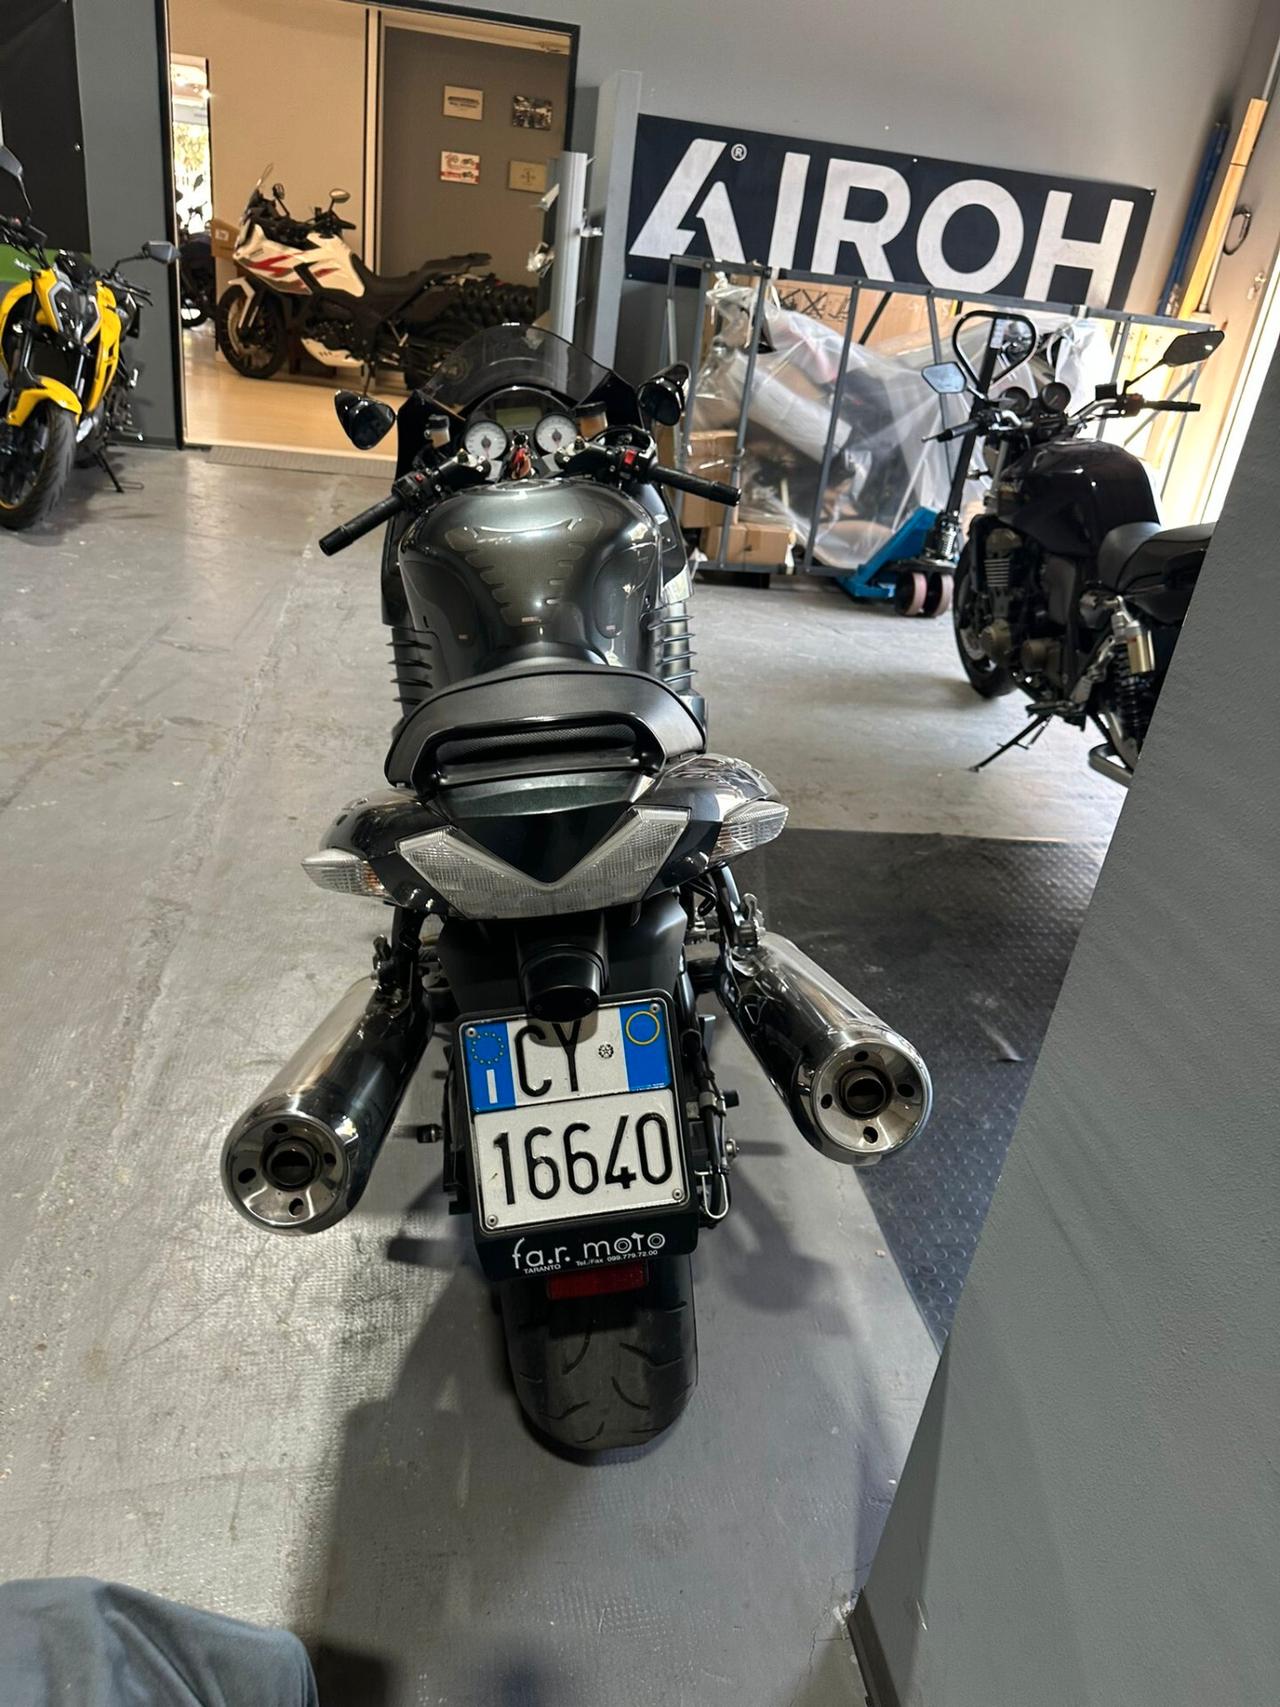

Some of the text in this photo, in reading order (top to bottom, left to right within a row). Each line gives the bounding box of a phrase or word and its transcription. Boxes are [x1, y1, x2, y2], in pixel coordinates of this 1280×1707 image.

[629, 138, 1135, 303] AIROH
[486, 1069, 498, 1104] I
[514, 1020, 581, 1097] CY
[493, 1112, 673, 1205] 16640
[524, 1263, 561, 1274] TARANTO
